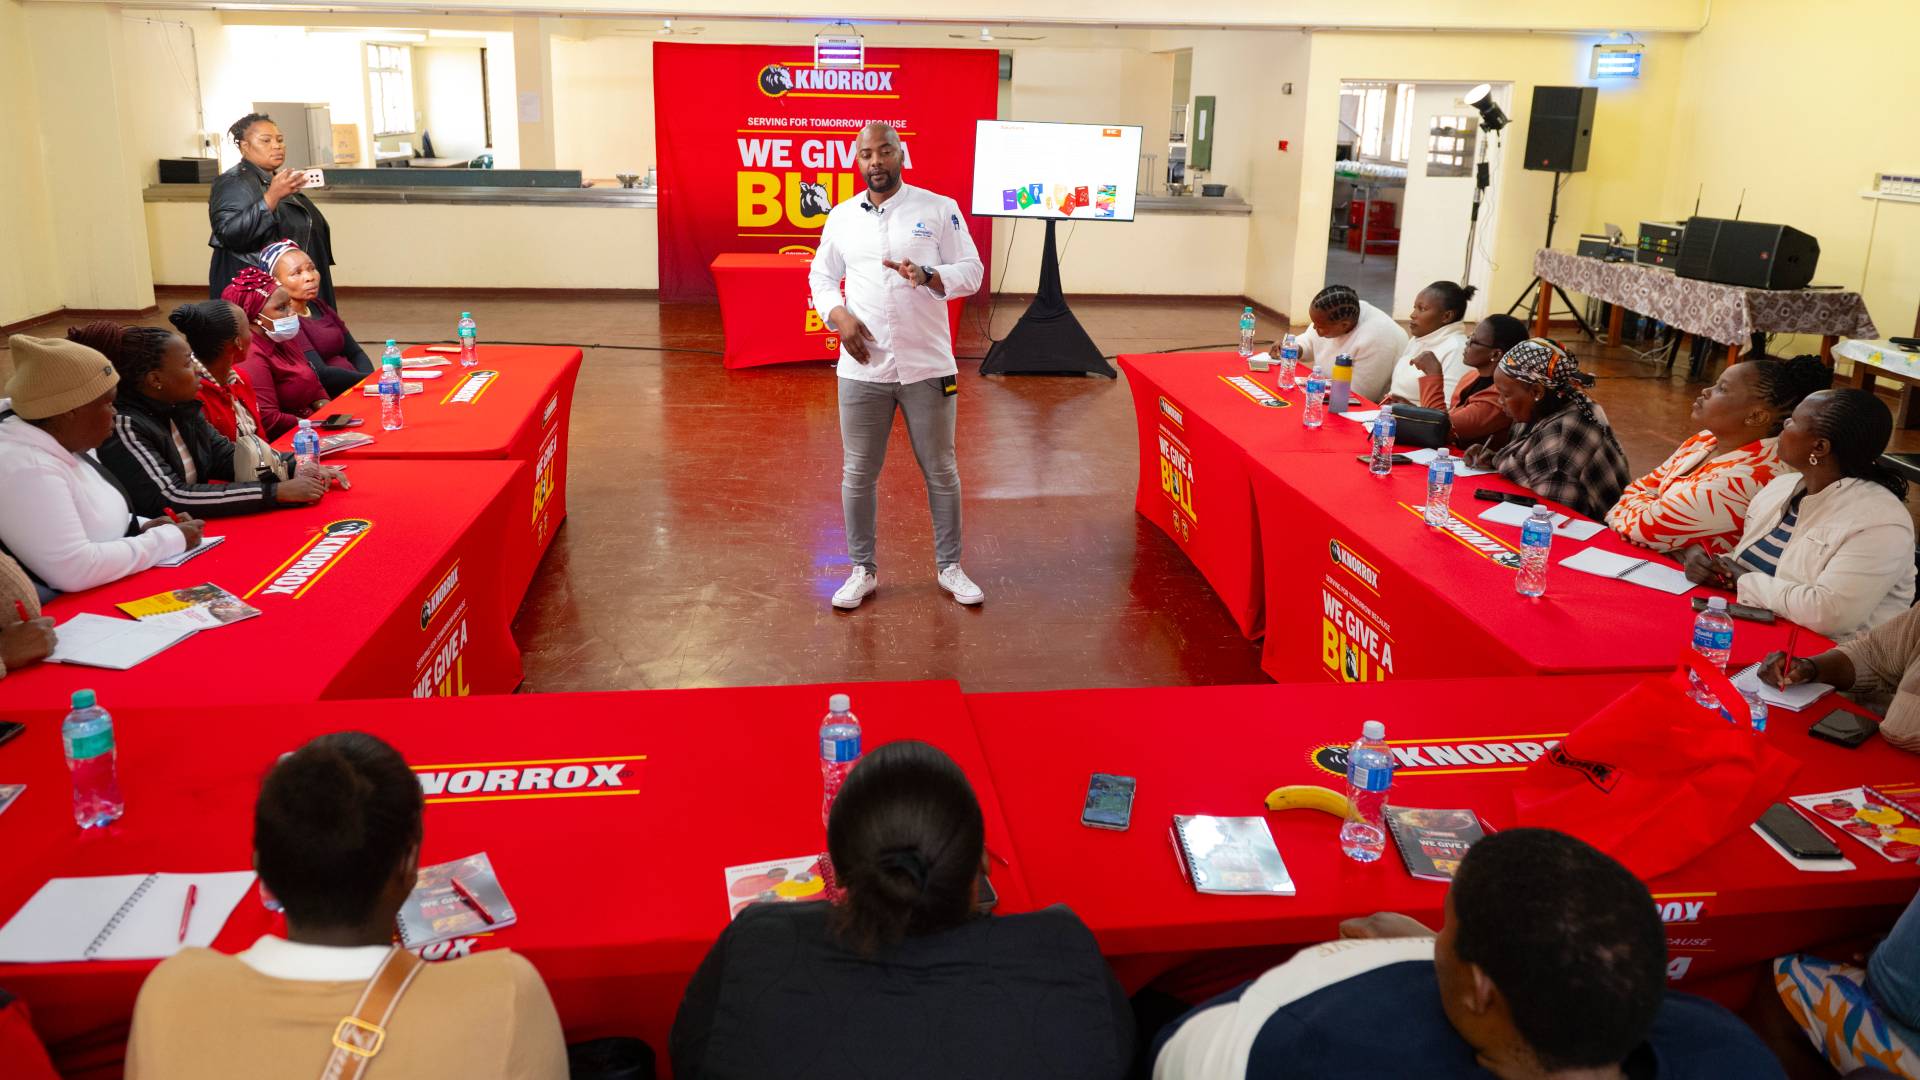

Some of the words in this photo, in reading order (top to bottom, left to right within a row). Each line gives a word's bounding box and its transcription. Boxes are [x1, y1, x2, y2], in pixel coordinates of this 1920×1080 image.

[795, 69, 893, 91] KNORROX
[747, 117, 788, 127] SERVING
[790, 118, 808, 127] FOR
[810, 118, 863, 128] TOMORROW
[737, 138, 793, 168] WE
[801, 139, 857, 169] GIV
[1160, 454, 1198, 523] BULL
[261, 537, 352, 595] KNORROX
[1341, 548, 1378, 589] KNORROX
[1322, 588, 1344, 628] WE
[1345, 609, 1379, 661] GIVE
[1381, 641, 1394, 675] A
[433, 629, 459, 687] GIVE
[460, 618, 468, 650] A
[416, 763, 626, 794] NORROX
[1418, 839, 1438, 848] WE
[1437, 841, 1463, 849] GIVE
